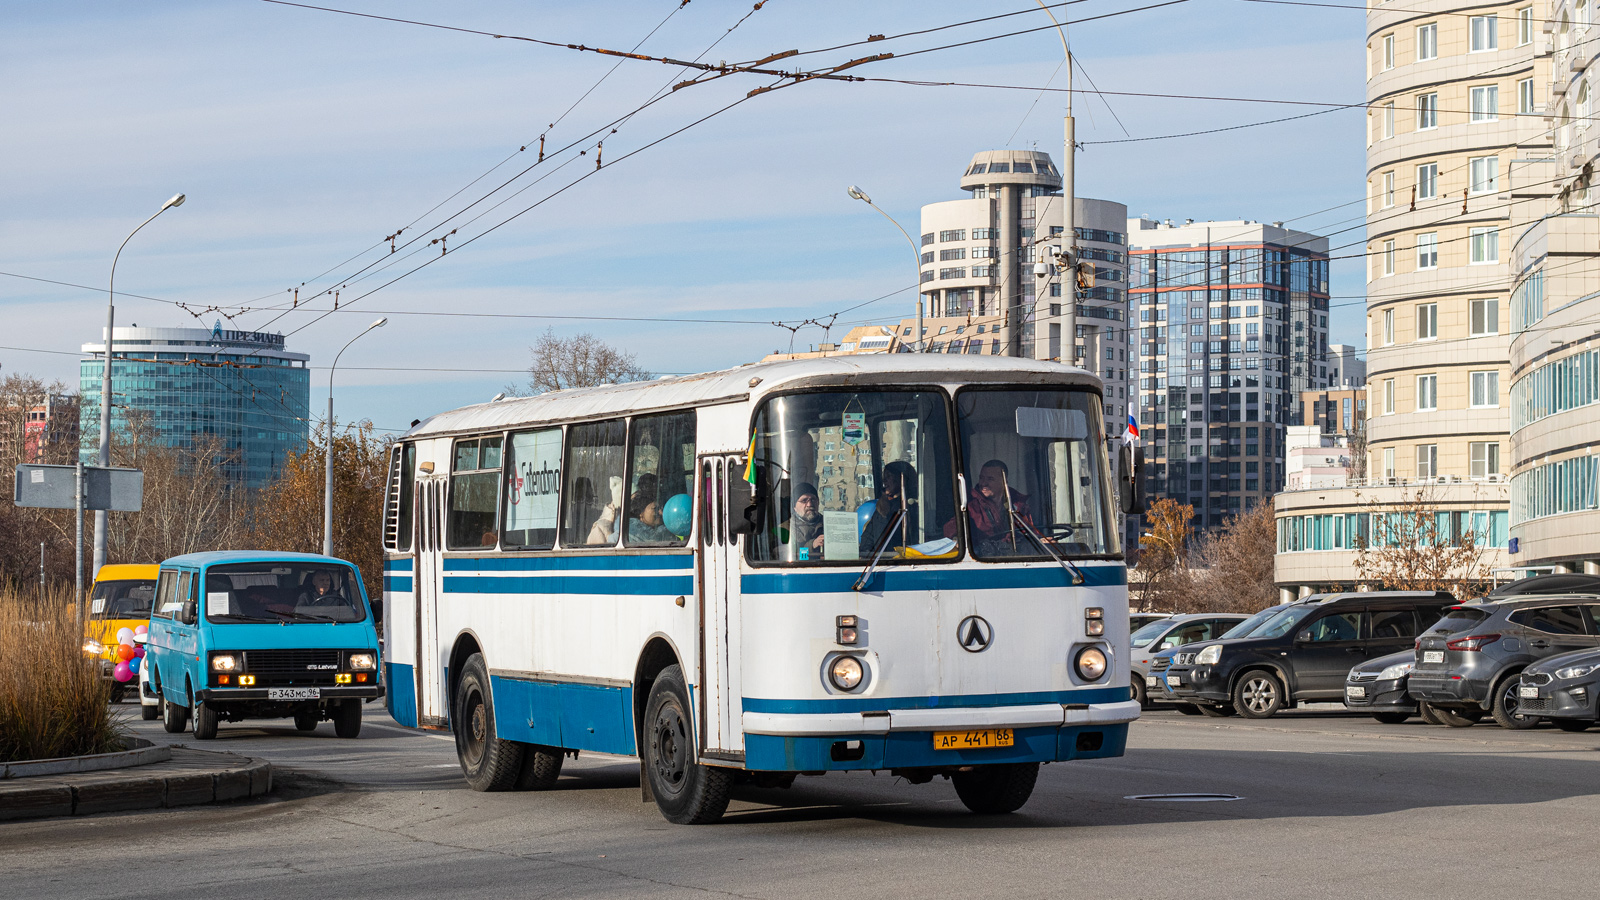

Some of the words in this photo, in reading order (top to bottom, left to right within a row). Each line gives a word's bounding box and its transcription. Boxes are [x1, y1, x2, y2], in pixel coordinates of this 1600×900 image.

[942, 736, 957, 747] АР
[964, 731, 988, 746] 441
[996, 729, 1009, 740] 66
